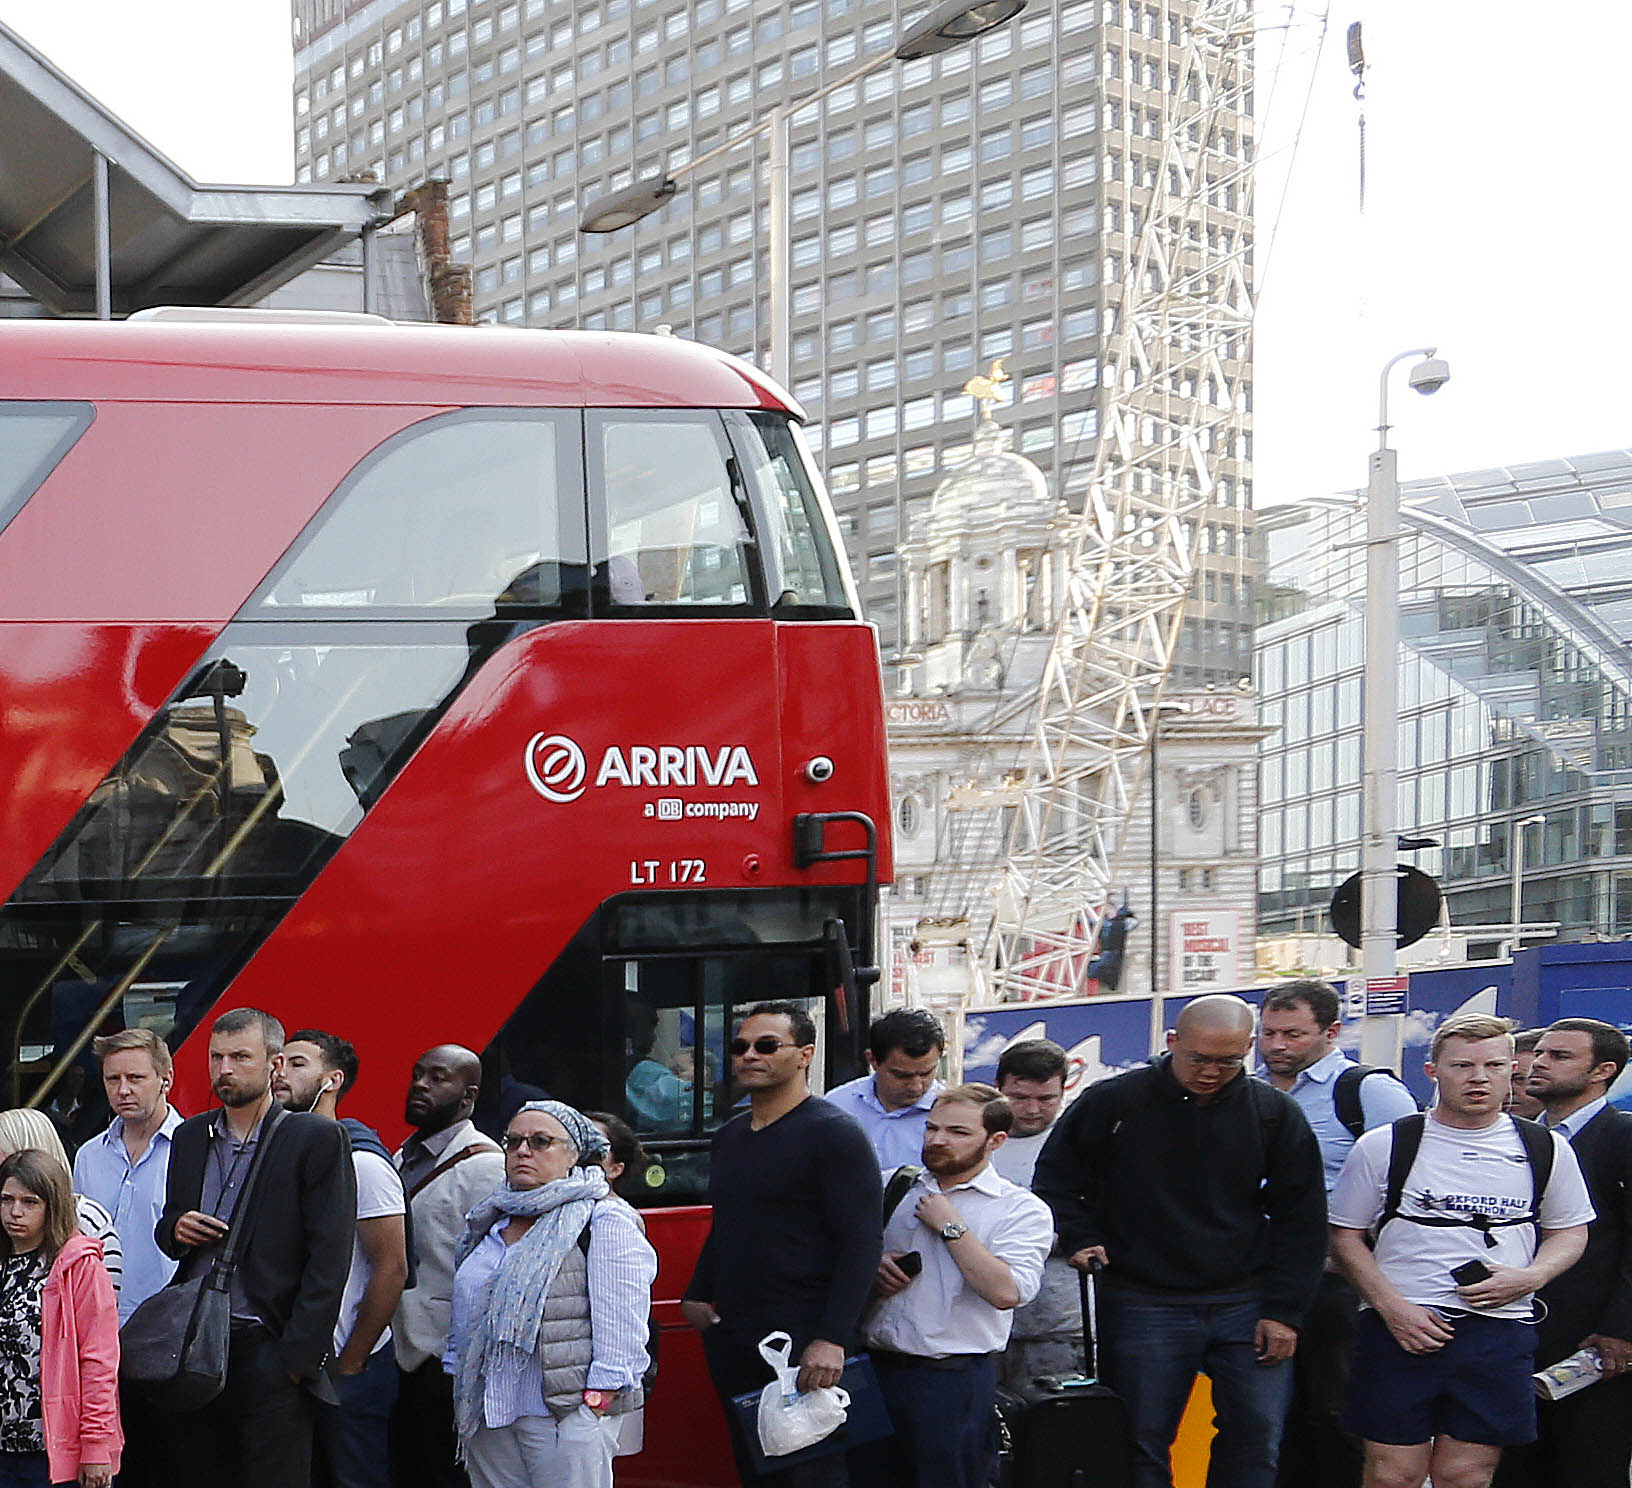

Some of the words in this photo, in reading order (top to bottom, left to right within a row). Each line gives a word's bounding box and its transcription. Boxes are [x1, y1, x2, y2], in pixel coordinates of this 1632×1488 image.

[886, 702, 949, 722] CTORIA
[595, 746, 759, 787] ARRIVA
[643, 803, 655, 818] a
[659, 801, 681, 818] DB
[685, 802, 759, 821] company
[630, 861, 660, 884] LT
[669, 859, 706, 883] 172
[1445, 1194, 1498, 1206] OXFORD
